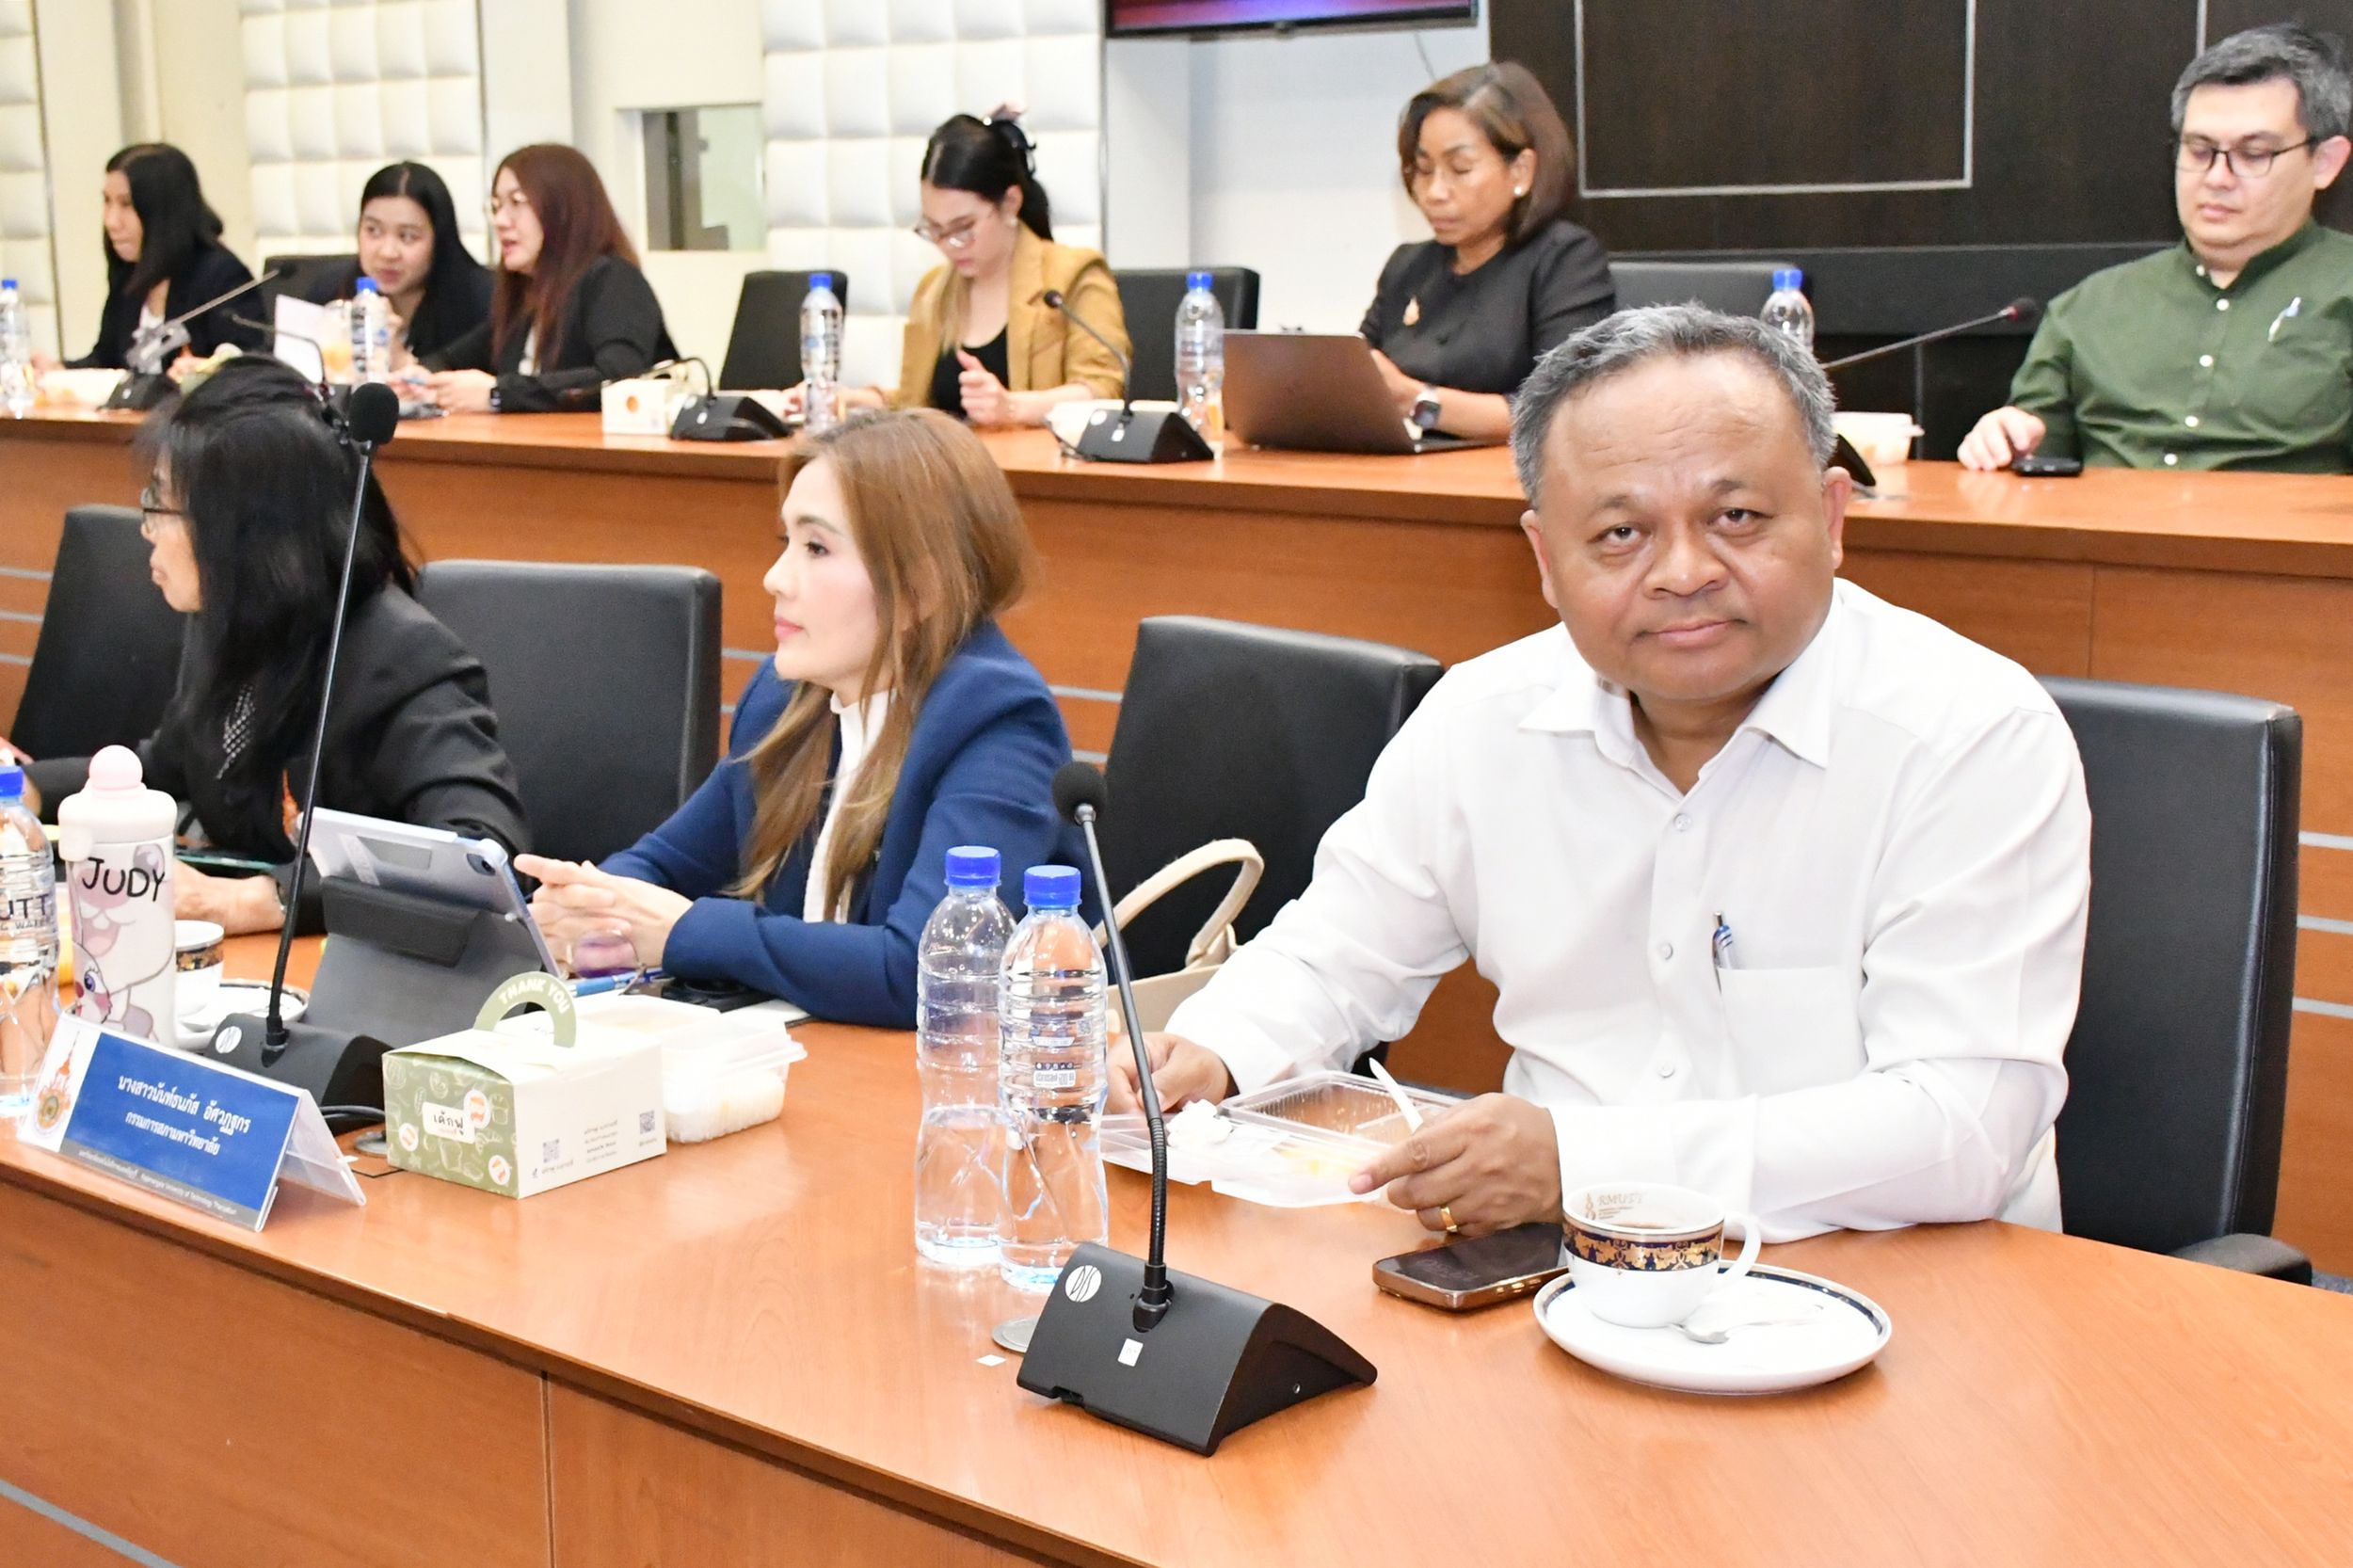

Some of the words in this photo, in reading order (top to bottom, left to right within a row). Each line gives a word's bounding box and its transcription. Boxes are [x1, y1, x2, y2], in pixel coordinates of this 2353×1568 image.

[82, 856, 166, 902] JUDY
[499, 978, 547, 1004] THANK
[547, 982, 571, 1015] YOU
[124, 1112, 221, 1156] กรรมการสภามหาวิทยาลัย
